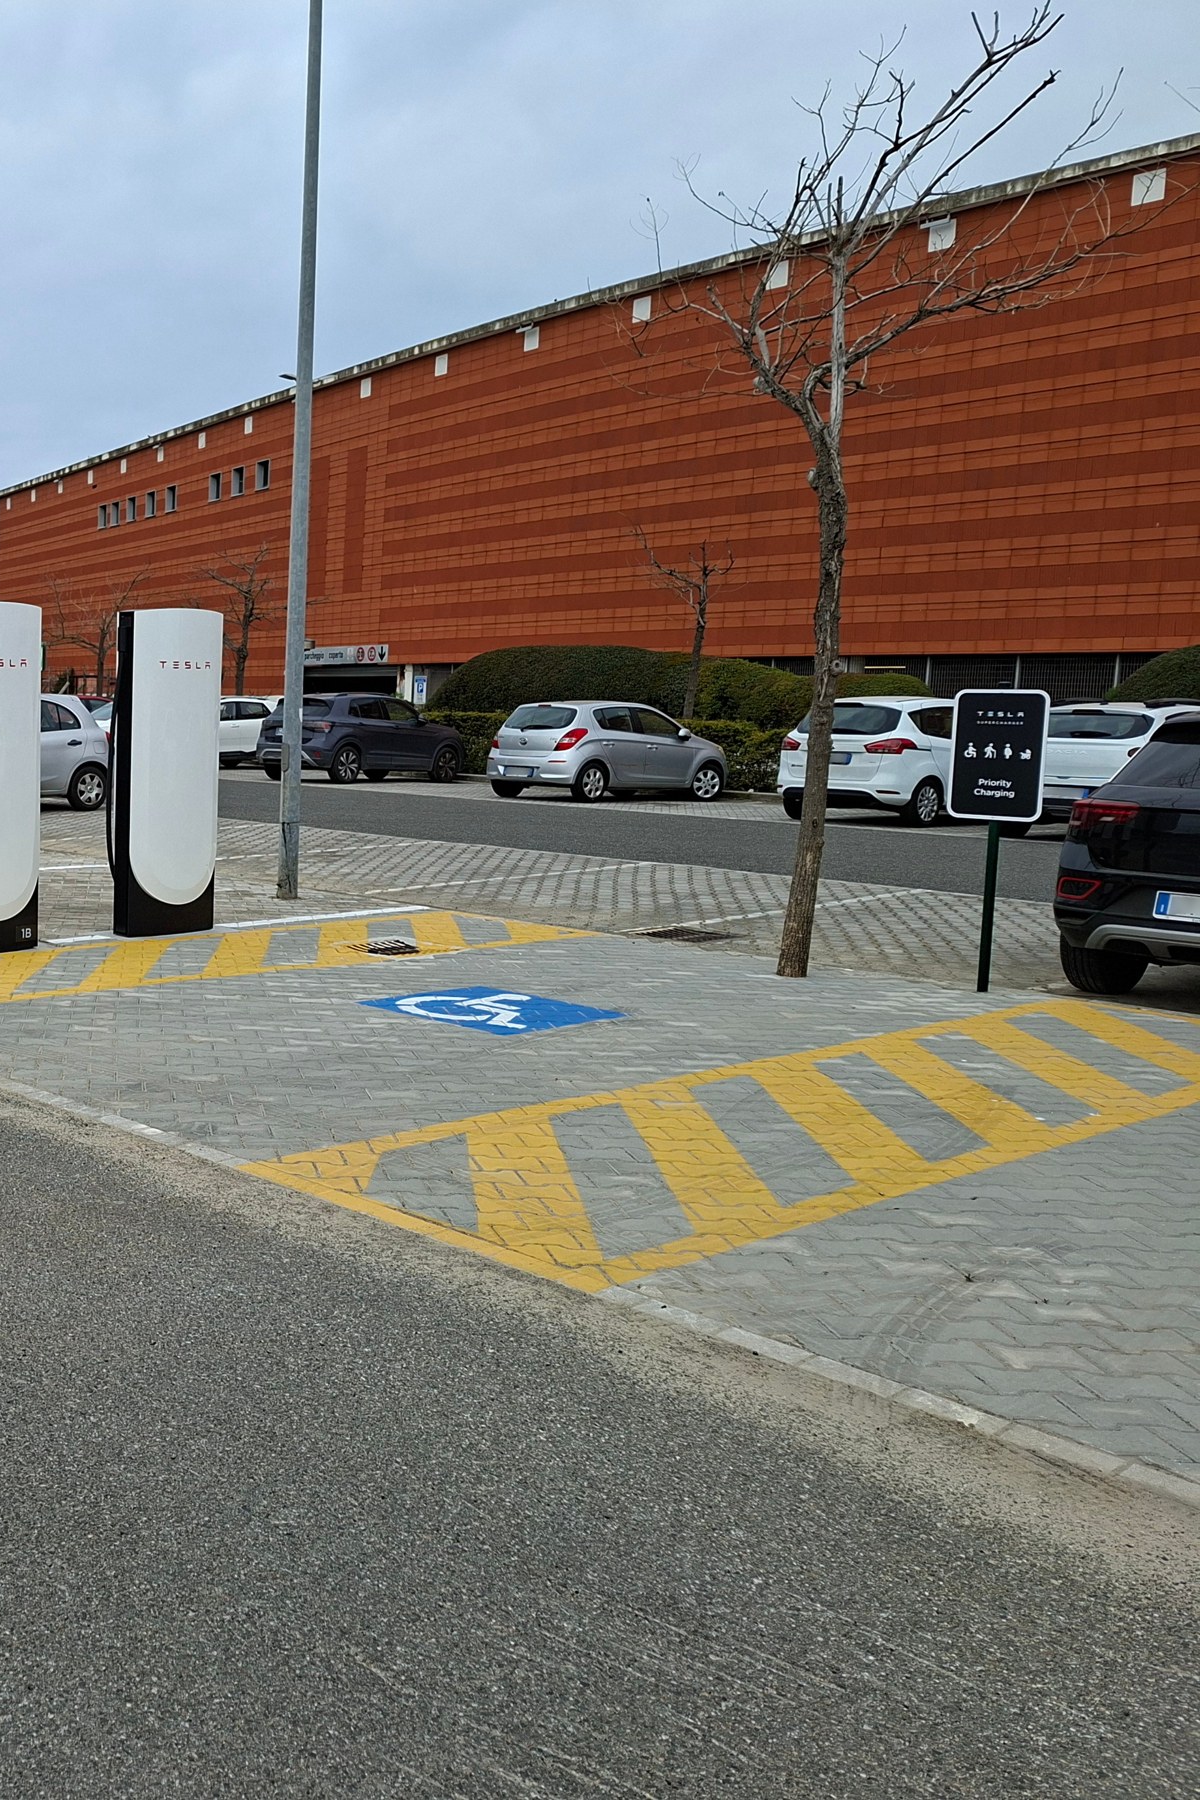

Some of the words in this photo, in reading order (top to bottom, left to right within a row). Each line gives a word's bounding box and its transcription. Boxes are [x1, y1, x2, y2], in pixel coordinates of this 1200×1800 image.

[159, 661, 211, 669] TESLA
[976, 710, 1025, 718] TESLA
[978, 778, 1012, 788] Priority
[973, 788, 1015, 798] Charging
[21, 927, 32, 938] 1B
